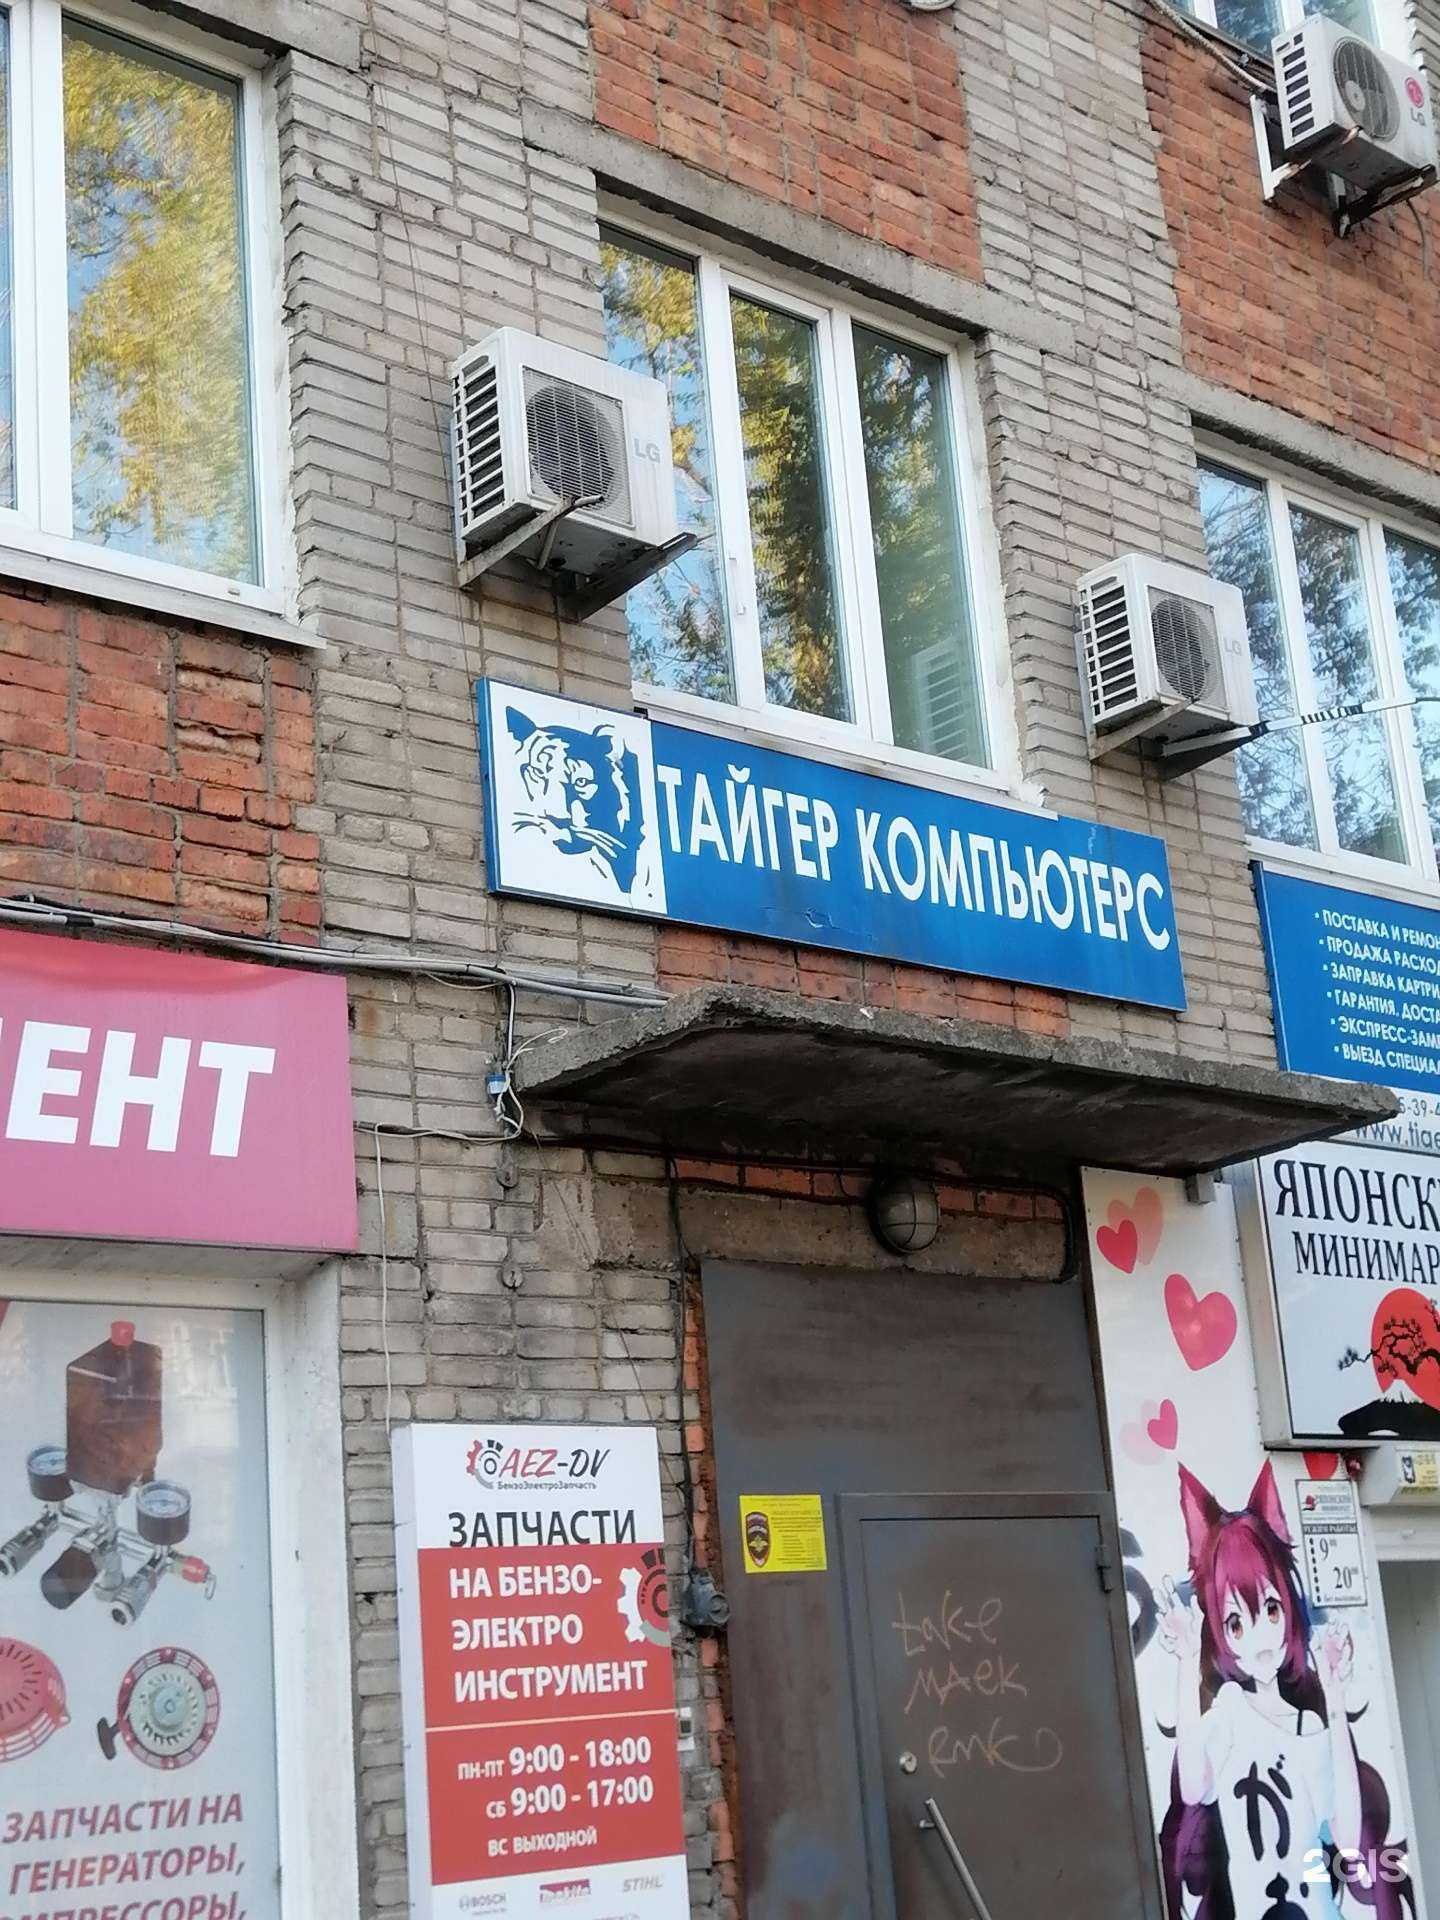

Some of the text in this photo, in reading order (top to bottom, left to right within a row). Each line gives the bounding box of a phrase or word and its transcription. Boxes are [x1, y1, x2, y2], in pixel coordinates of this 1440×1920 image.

[634, 437, 661, 464] LG
[656, 764, 1171, 951] ТАЙГЕР КОМПЬЮТЕРС
[1322, 909, 1389, 939] ПОСТАВКА
[1391, 924, 1400, 941] И
[1326, 935, 1392, 964] ПРОДАЖА
[1330, 962, 1395, 991] ЗАПРАВКА
[1342, 1043, 1386, 1068] ВЫЕЗД
[0, 1017, 277, 1158] ЕНТ
[1273, 1159, 1440, 1232] ЯПОНСК
[1292, 1231, 1440, 1285] МИНИМАР
[448, 1509, 637, 1548] ЗАПЧАСТИ
[449, 1563, 602, 1599] НА БЕНЗО-
[452, 1613, 583, 1651] ЭЛЕКТРО
[454, 1660, 647, 1703] ИНСТРУМЕНТ
[508, 1743, 565, 1776] 9:00
[585, 1736, 652, 1768] 18:00
[510, 1783, 567, 1817] 9:00
[586, 1774, 654, 1808] 17:00
[1, 1793, 243, 1844] ЗАПЧАСТИ НА
[488, 1825, 598, 1857] ВС ВЫХОДНОЙ
[8, 1842, 246, 1895] ГЕНЕРАТОРЫ,
[622, 1873, 664, 1893] STIHL
